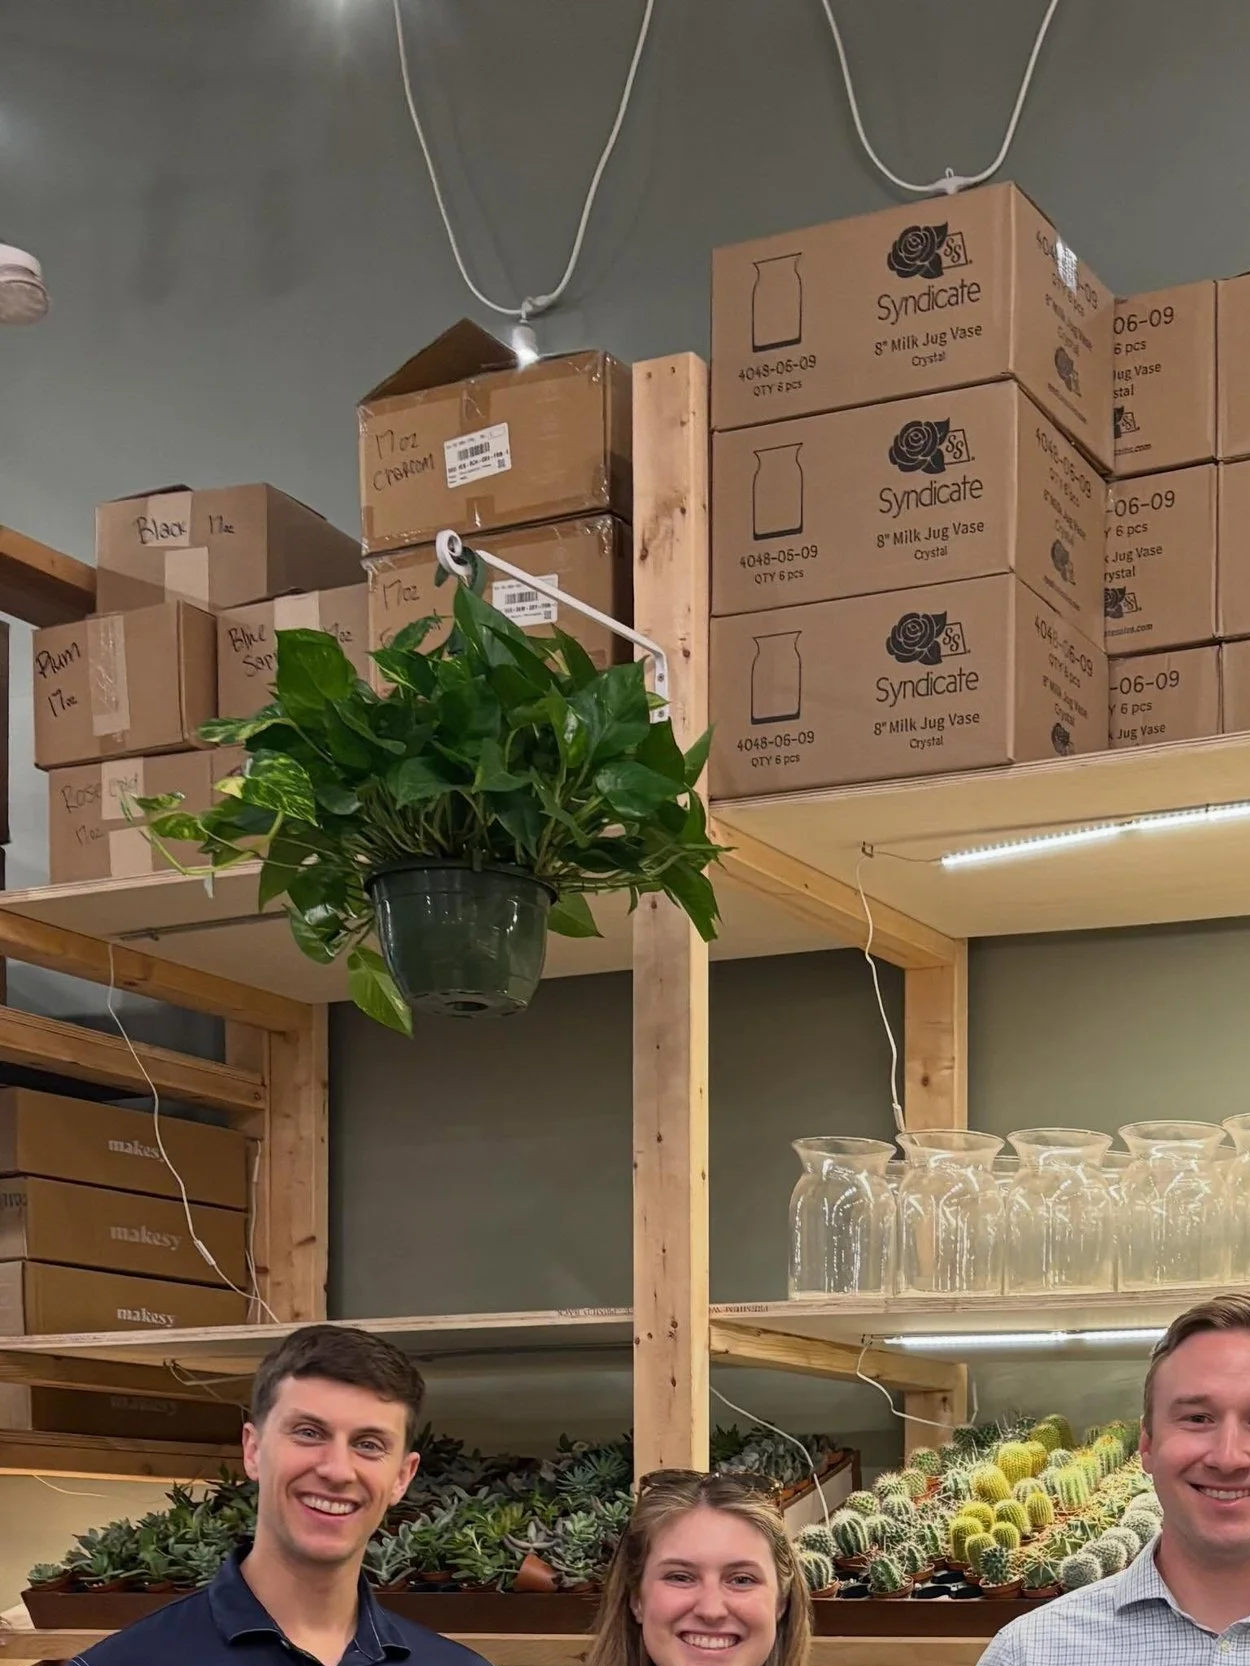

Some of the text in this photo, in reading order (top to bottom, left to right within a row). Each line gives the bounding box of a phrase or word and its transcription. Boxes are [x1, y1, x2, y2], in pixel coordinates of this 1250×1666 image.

[877, 278, 982, 325] Syndicate
[1113, 306, 1174, 335] 06-09
[891, 333, 918, 352] Milk
[923, 331, 947, 348] Jug
[951, 324, 983, 341] Vase
[911, 351, 946, 367] Crystal
[1135, 362, 1161, 375] Vase
[1113, 385, 1134, 398] stal
[879, 476, 983, 518] Syndicate
[1105, 491, 1175, 517] -06-09
[893, 527, 921, 545] Milk
[924, 525, 949, 542] Jug
[952, 520, 984, 536] Vase
[1127, 523, 1148, 538] pcs
[739, 545, 818, 569] 4048-06-09
[914, 546, 948, 560] Crystal
[1112, 550, 1133, 564] Jug
[1136, 544, 1162, 558] Vase
[754, 571, 776, 585] QTY
[788, 568, 804, 581] pcs
[1105, 567, 1135, 582] rystal
[36, 642, 81, 679] Plum
[876, 667, 979, 707] Syndicate
[1109, 670, 1180, 695] -06-09
[1131, 701, 1152, 715] pcs
[874, 711, 980, 736] 8" Milk Jug Vase
[1117, 728, 1137, 741] Jug
[1140, 723, 1166, 735] Vase
[737, 731, 815, 752] 4048-06-09
[909, 735, 944, 750] Crystal
[751, 755, 773, 769] QTY
[784, 753, 800, 765] pcs
[110, 1224, 182, 1250] makesy
[117, 1307, 176, 1327] makesy
